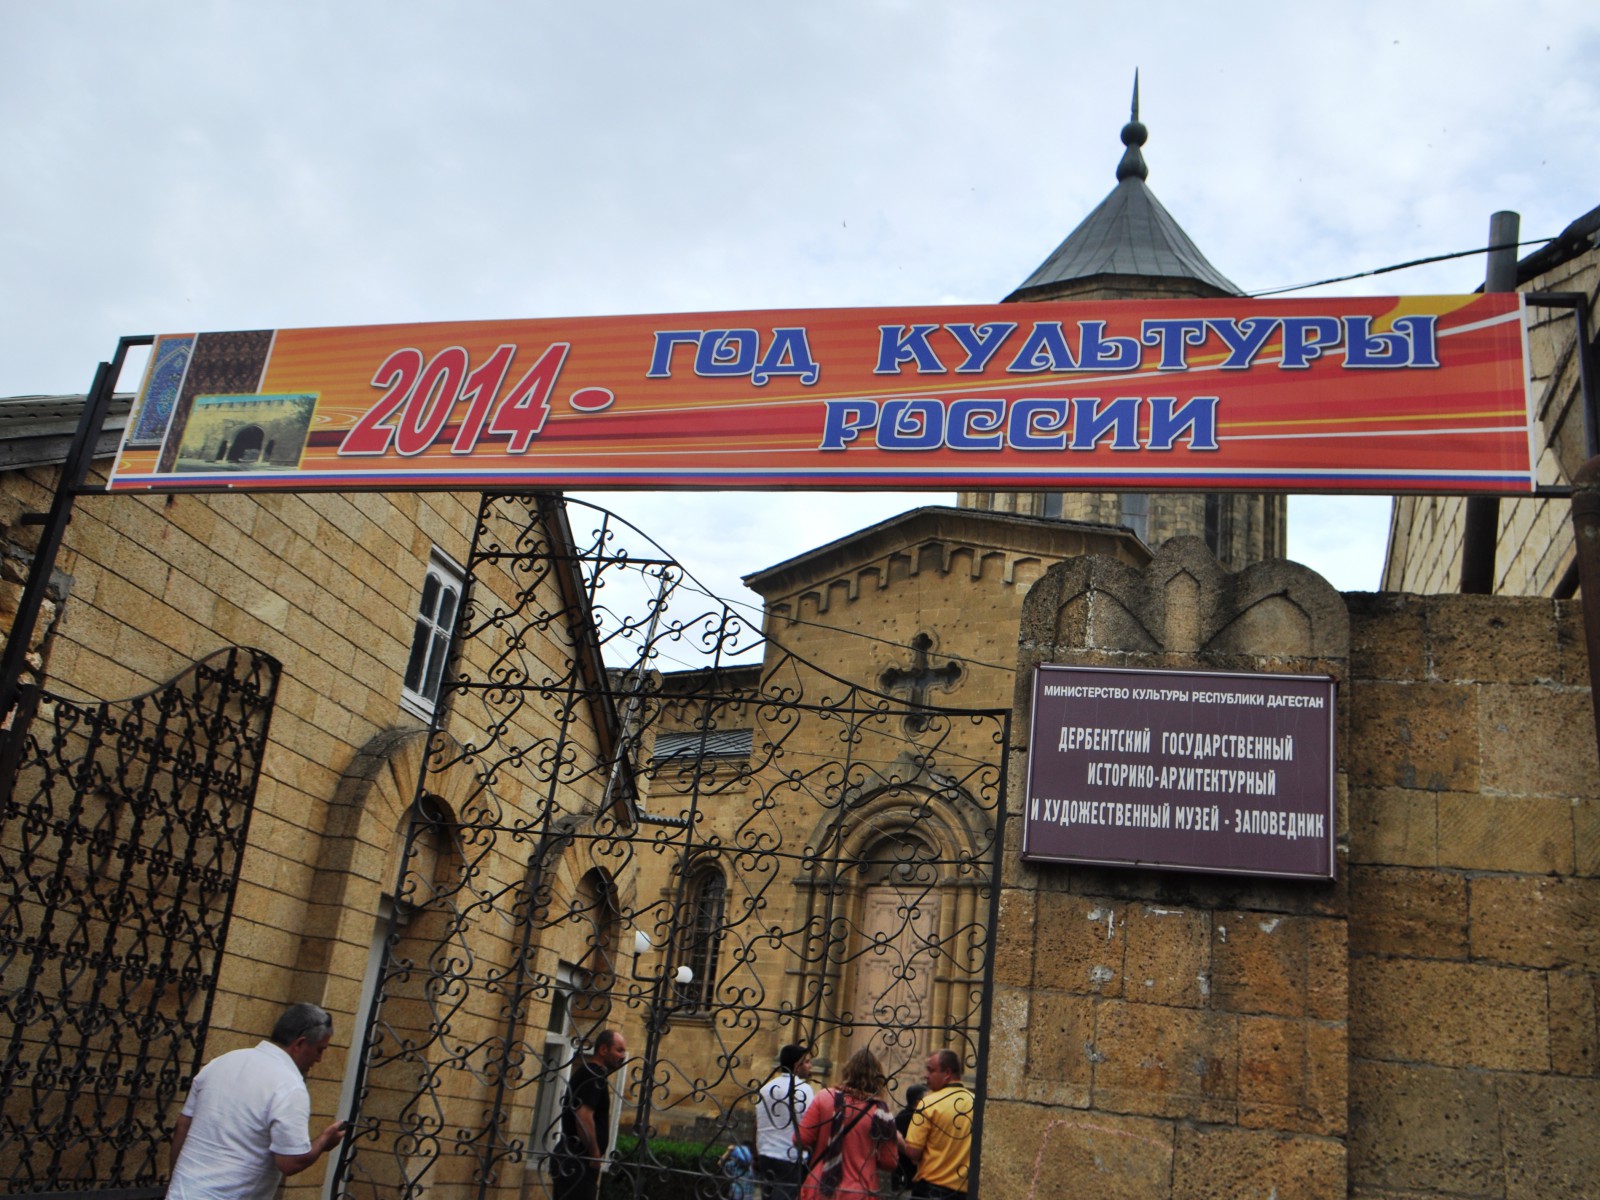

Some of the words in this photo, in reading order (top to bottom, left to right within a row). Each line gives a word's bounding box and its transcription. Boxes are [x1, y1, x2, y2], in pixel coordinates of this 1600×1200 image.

[646, 327, 820, 386] ГОД
[873, 314, 1440, 374] КУЛЬТУРЫ
[818, 396, 1220, 451] РОССИИ
[1043, 685, 1130, 700] МИНИСТЕРСТВО
[1132, 688, 1189, 702] КУЛЬТУРЫ
[1192, 691, 1265, 706] РЕСПУБЛИКИ
[1266, 694, 1324, 709] ДАГЕСТАН
[1058, 726, 1151, 754] ДЕРБЕНТСКИЙ
[1161, 731, 1293, 761] ГОСУДАРСТВЕННЫЙ
[1087, 762, 1276, 796] ИСТОРИКО-АРХИТЕКТУРНЫЙ
[1030, 798, 1039, 821] И
[1043, 799, 1170, 830] ХУДОЖЕСТВЕННЫЙ
[1174, 804, 1219, 832] МУЗЕЙ
[1234, 808, 1325, 840] ЗАПОВЕДНИК
